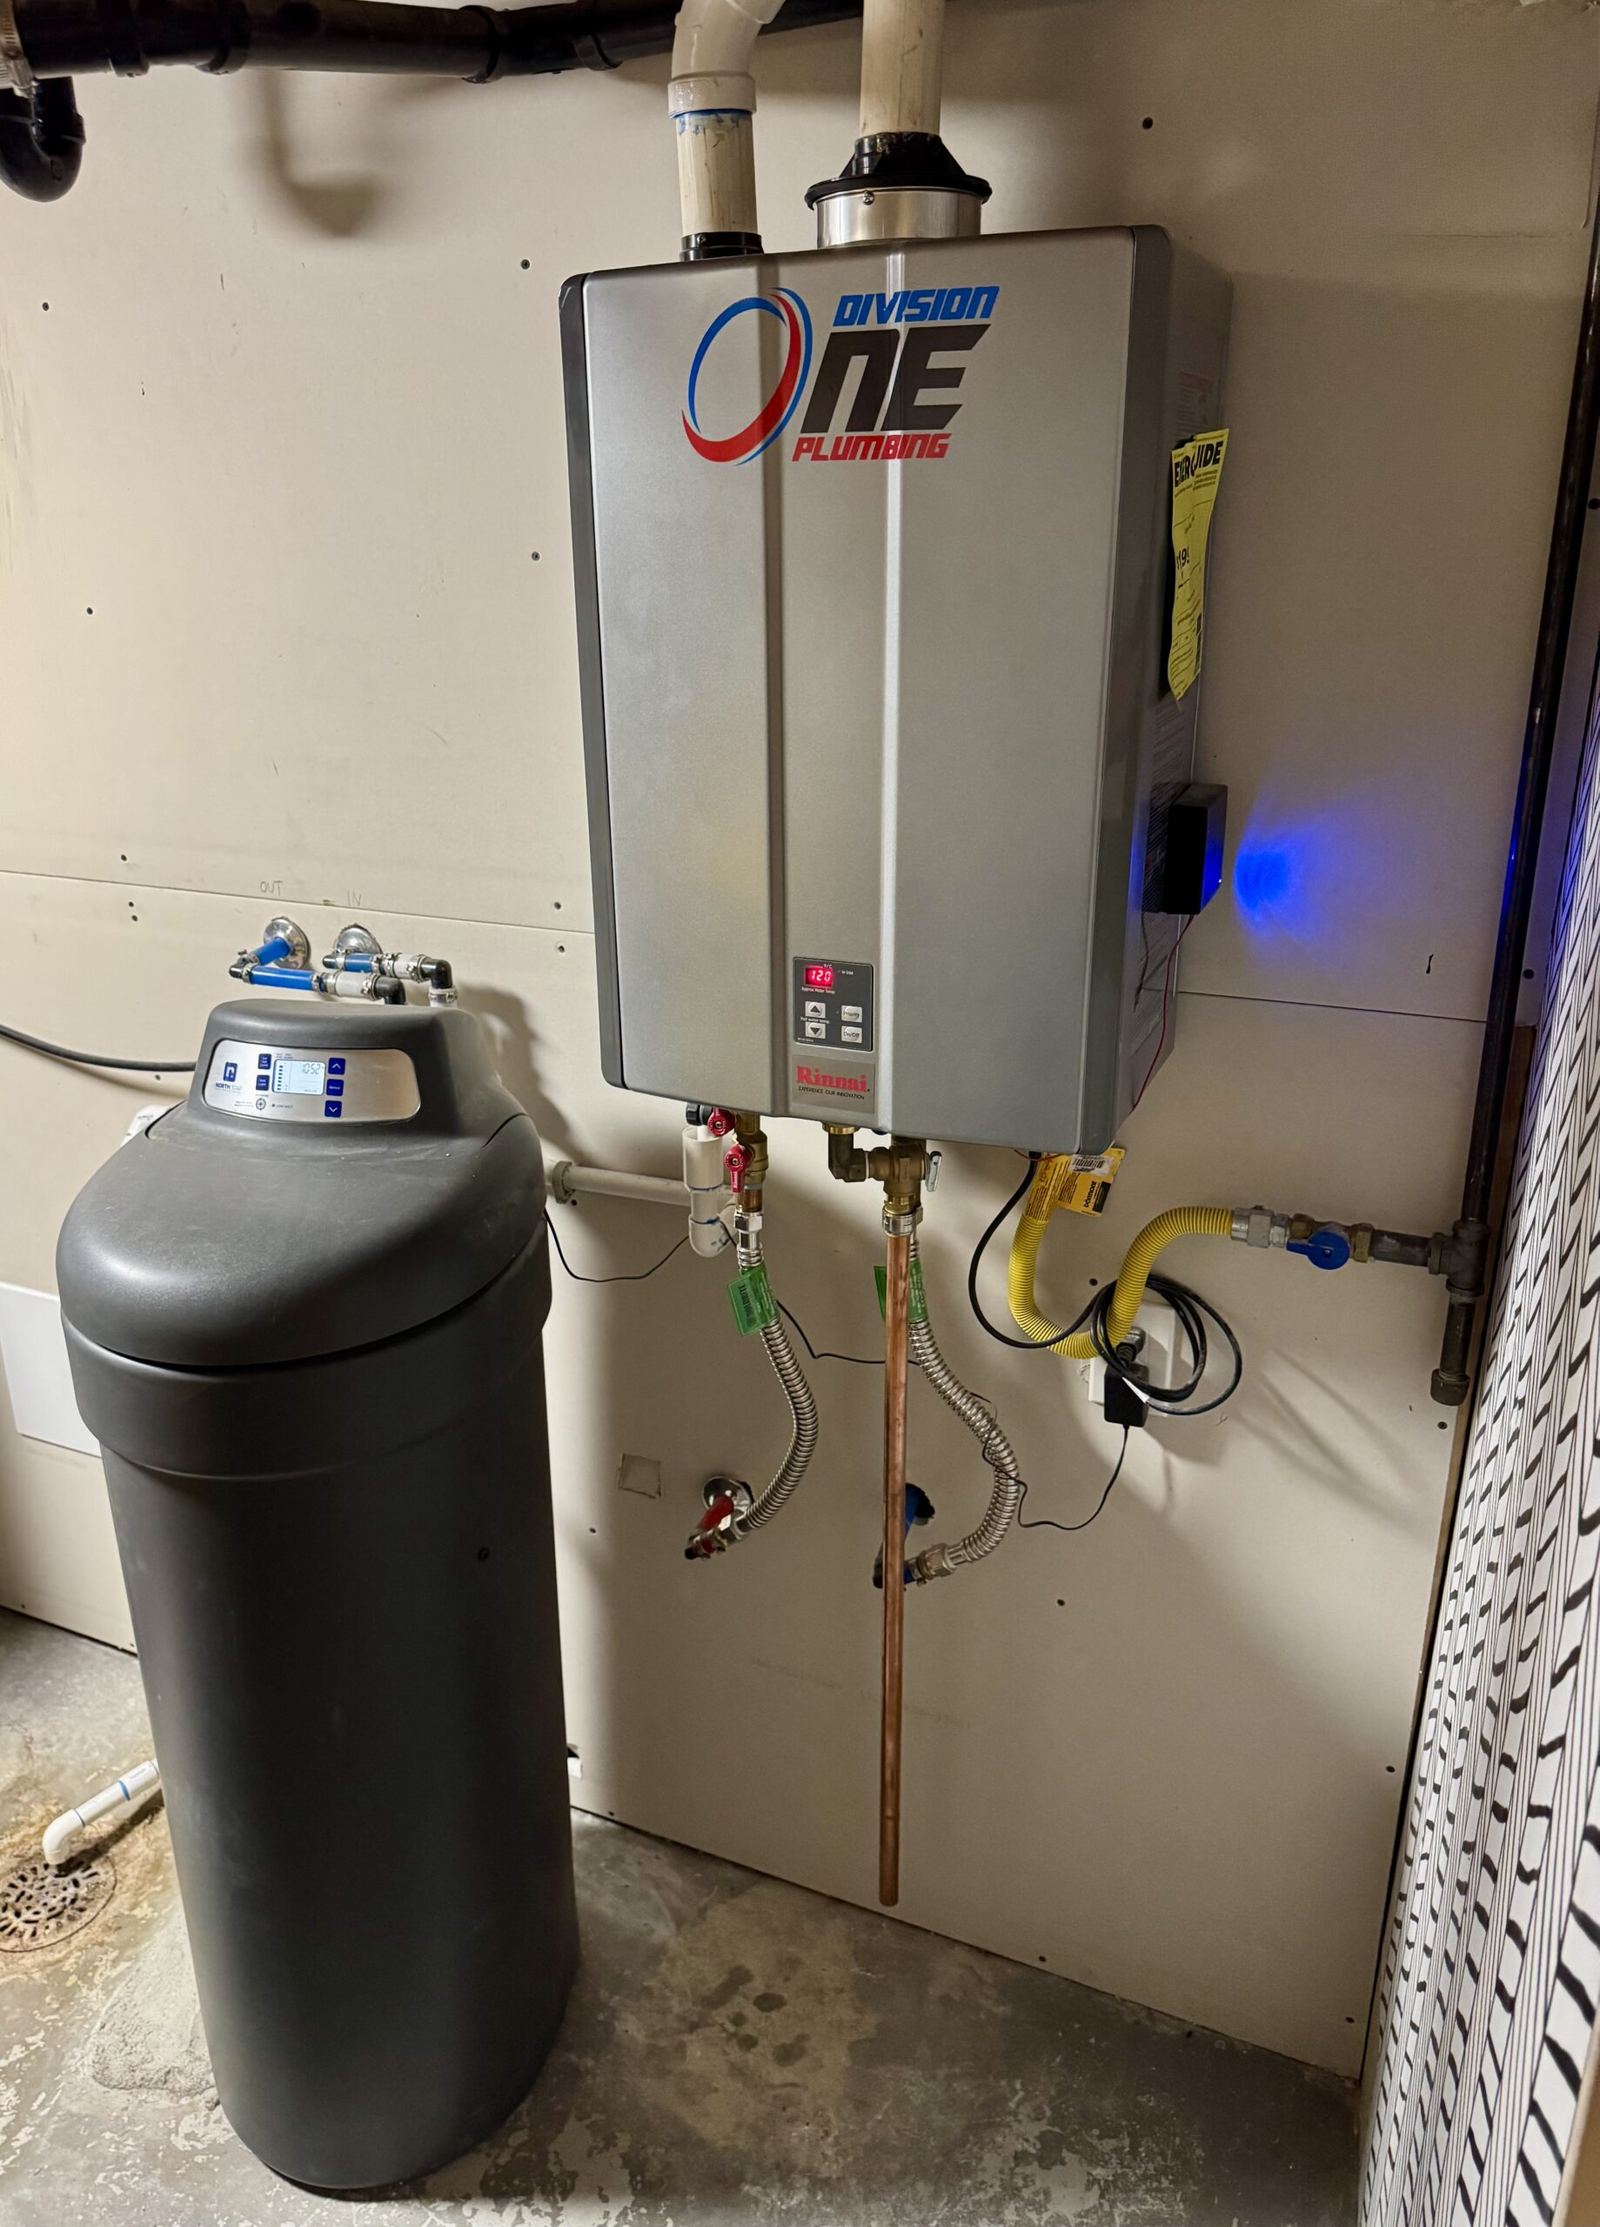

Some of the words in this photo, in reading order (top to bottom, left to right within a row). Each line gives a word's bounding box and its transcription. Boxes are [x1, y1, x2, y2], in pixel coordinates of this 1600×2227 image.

[832, 285, 1000, 327] DIVISION
[791, 432, 952, 462] PLUMBING
[260, 880, 283, 896] OUT
[347, 891, 362, 906] IN
[811, 969, 832, 982] 120
[797, 1066, 867, 1093] Rinnai
